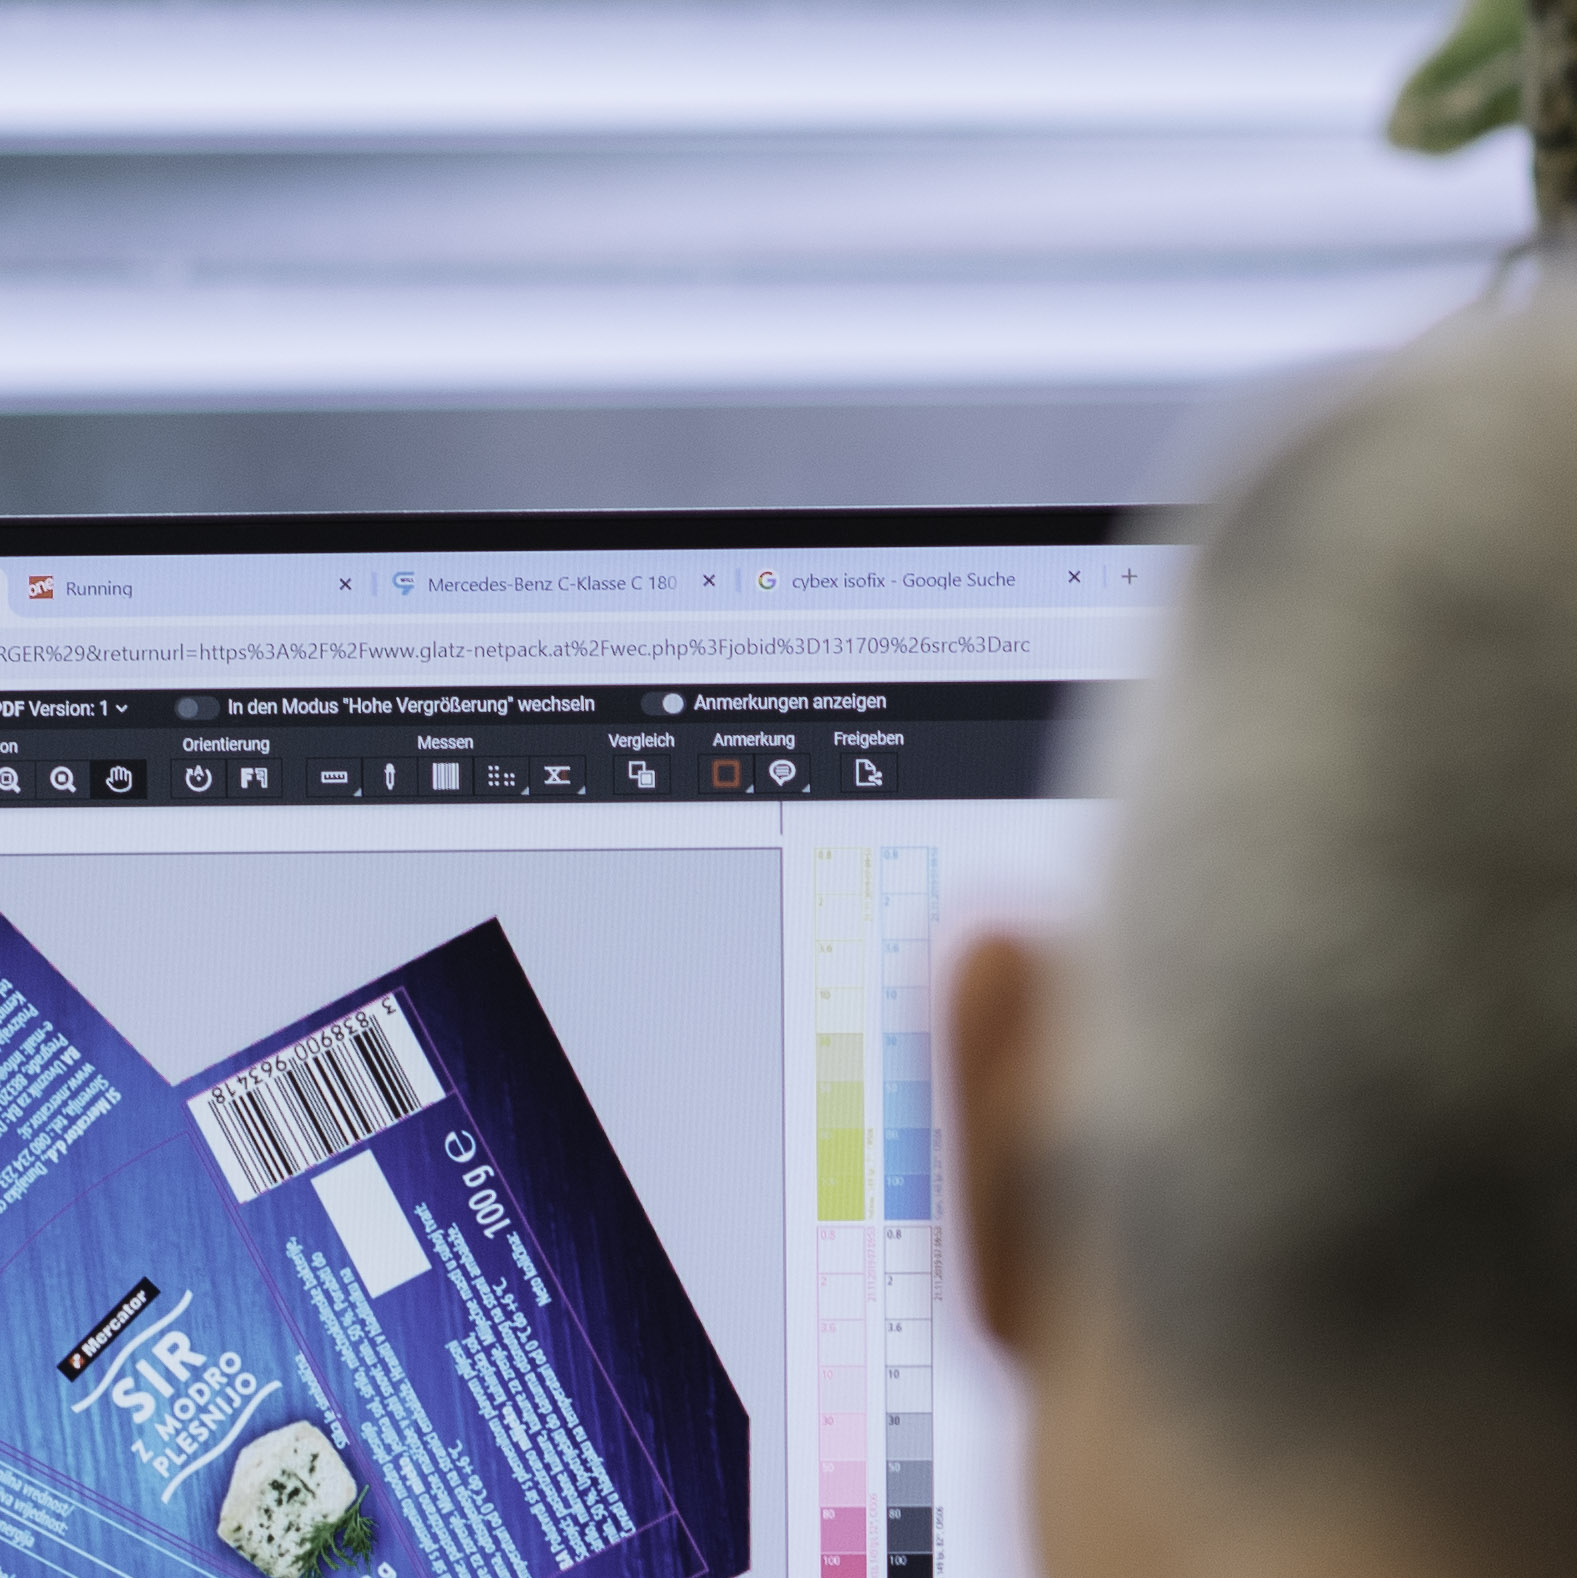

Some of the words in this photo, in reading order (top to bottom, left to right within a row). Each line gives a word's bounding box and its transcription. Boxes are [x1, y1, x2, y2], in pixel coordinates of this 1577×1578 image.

[66, 580, 132, 598] Running
[428, 575, 552, 591] Mercedes-Benz
[557, 575, 626, 591] C-Klasse
[631, 575, 642, 590] C
[648, 575, 676, 589] 180
[792, 572, 838, 591] cybex
[843, 572, 885, 587] isofix
[902, 571, 961, 590] Google
[967, 571, 1015, 586] Suche
[28, 700, 94, 717] Version:
[99, 700, 107, 717] 1
[228, 698, 243, 714] In
[247, 698, 277, 714] den
[282, 697, 338, 714] Modus
[342, 696, 392, 713] "Hohe
[395, 695, 513, 716] Vergrößerung"
[517, 694, 595, 712] wechseln
[693, 692, 808, 713] Anmerkungen
[812, 692, 886, 712] anzeigen
[182, 736, 269, 754] Orientierung
[415, 733, 473, 753] Messen
[608, 732, 674, 750] Vergleich
[712, 731, 794, 749] Anmerkung
[834, 729, 903, 748] Freigeben
[378, 995, 397, 1016] 3
[294, 1011, 370, 1059] 838900
[212, 1054, 288, 1104] 963418
[461, 1164, 495, 1190] g
[468, 1187, 512, 1240] 100
[80, 1290, 148, 1357] Mercator
[111, 1326, 207, 1424] SIR
[130, 1439, 154, 1463] Z
[155, 1351, 243, 1438] MODRO
[152, 1372, 259, 1478] PLESNIJO
